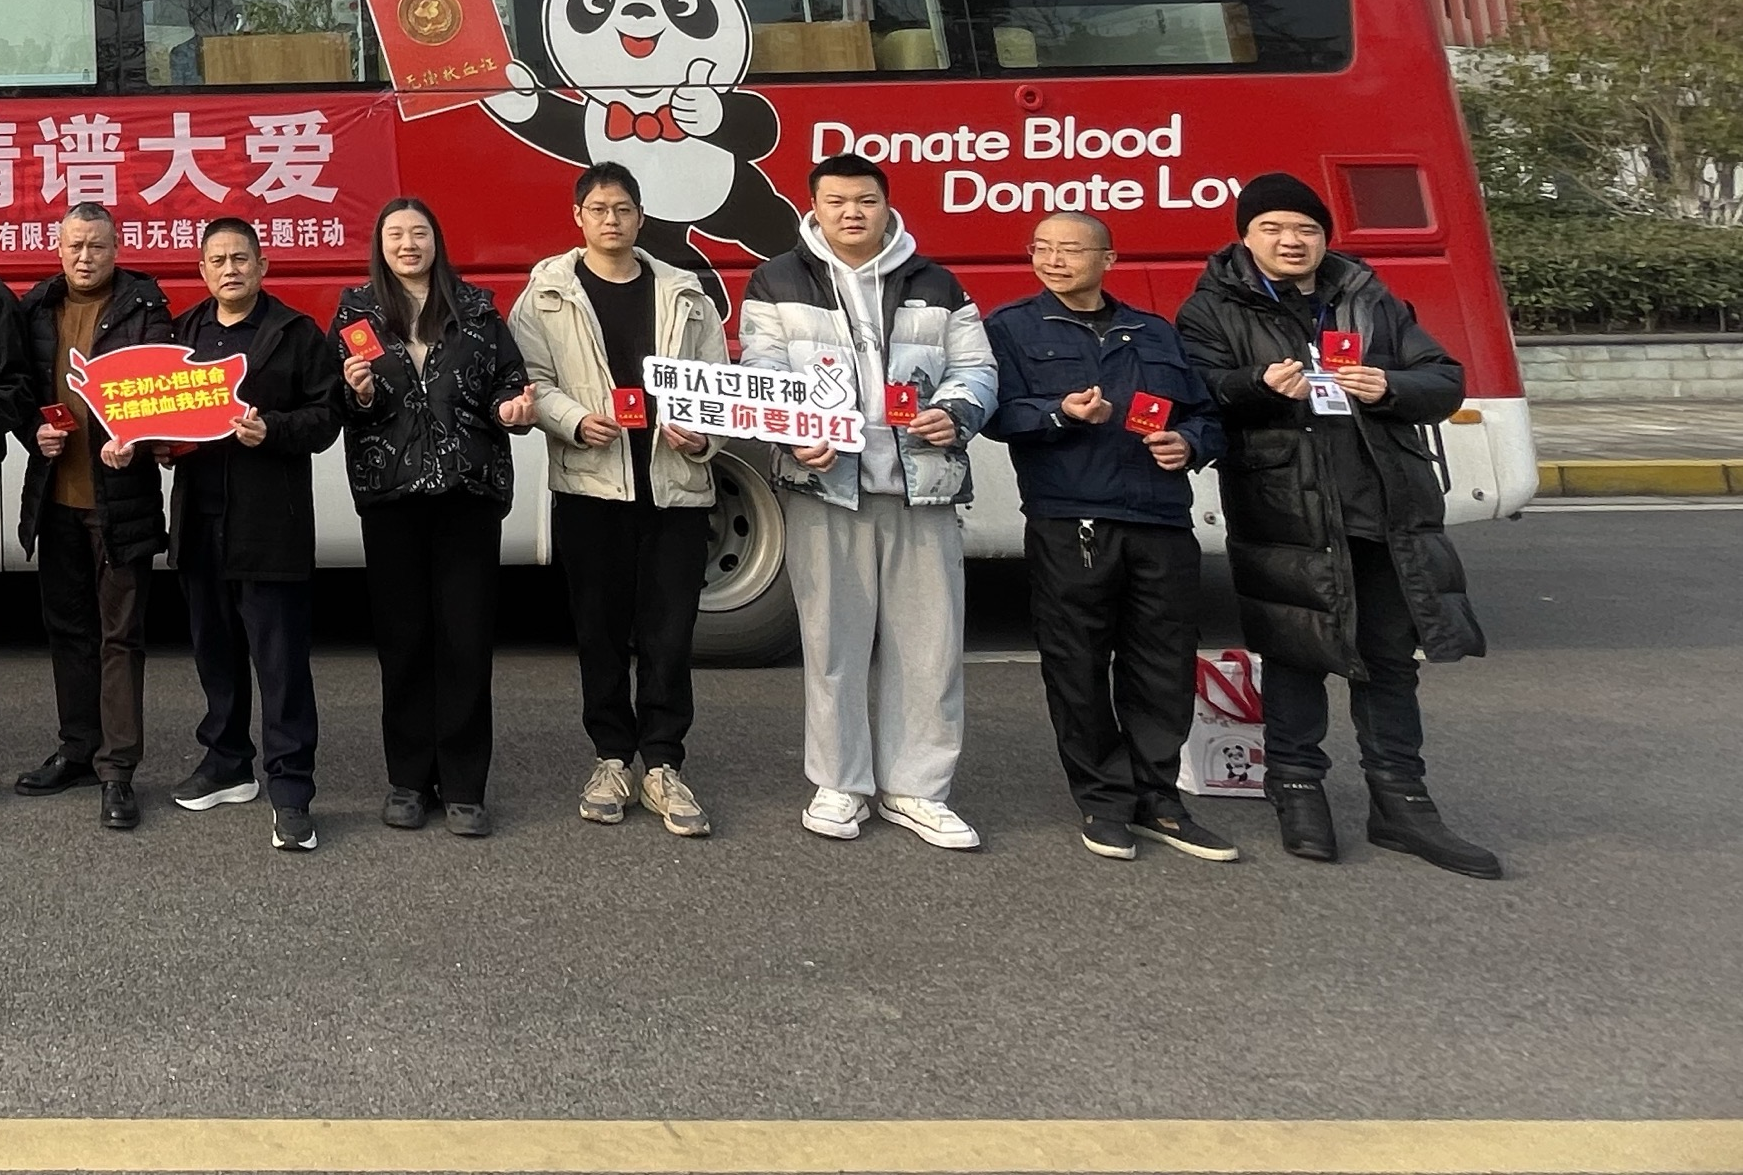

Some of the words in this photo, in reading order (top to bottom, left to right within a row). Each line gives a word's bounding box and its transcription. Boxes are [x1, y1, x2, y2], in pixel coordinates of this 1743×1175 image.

[811, 122, 1010, 164] Donate
[1023, 113, 1182, 161] Blood
[943, 170, 1144, 214] Donate
[100, 366, 226, 401] 不忘初心担使命
[105, 387, 231, 422] 无偿献血我先行
[652, 363, 808, 405] 确认过眼神
[667, 396, 858, 444] 这是你要的红
